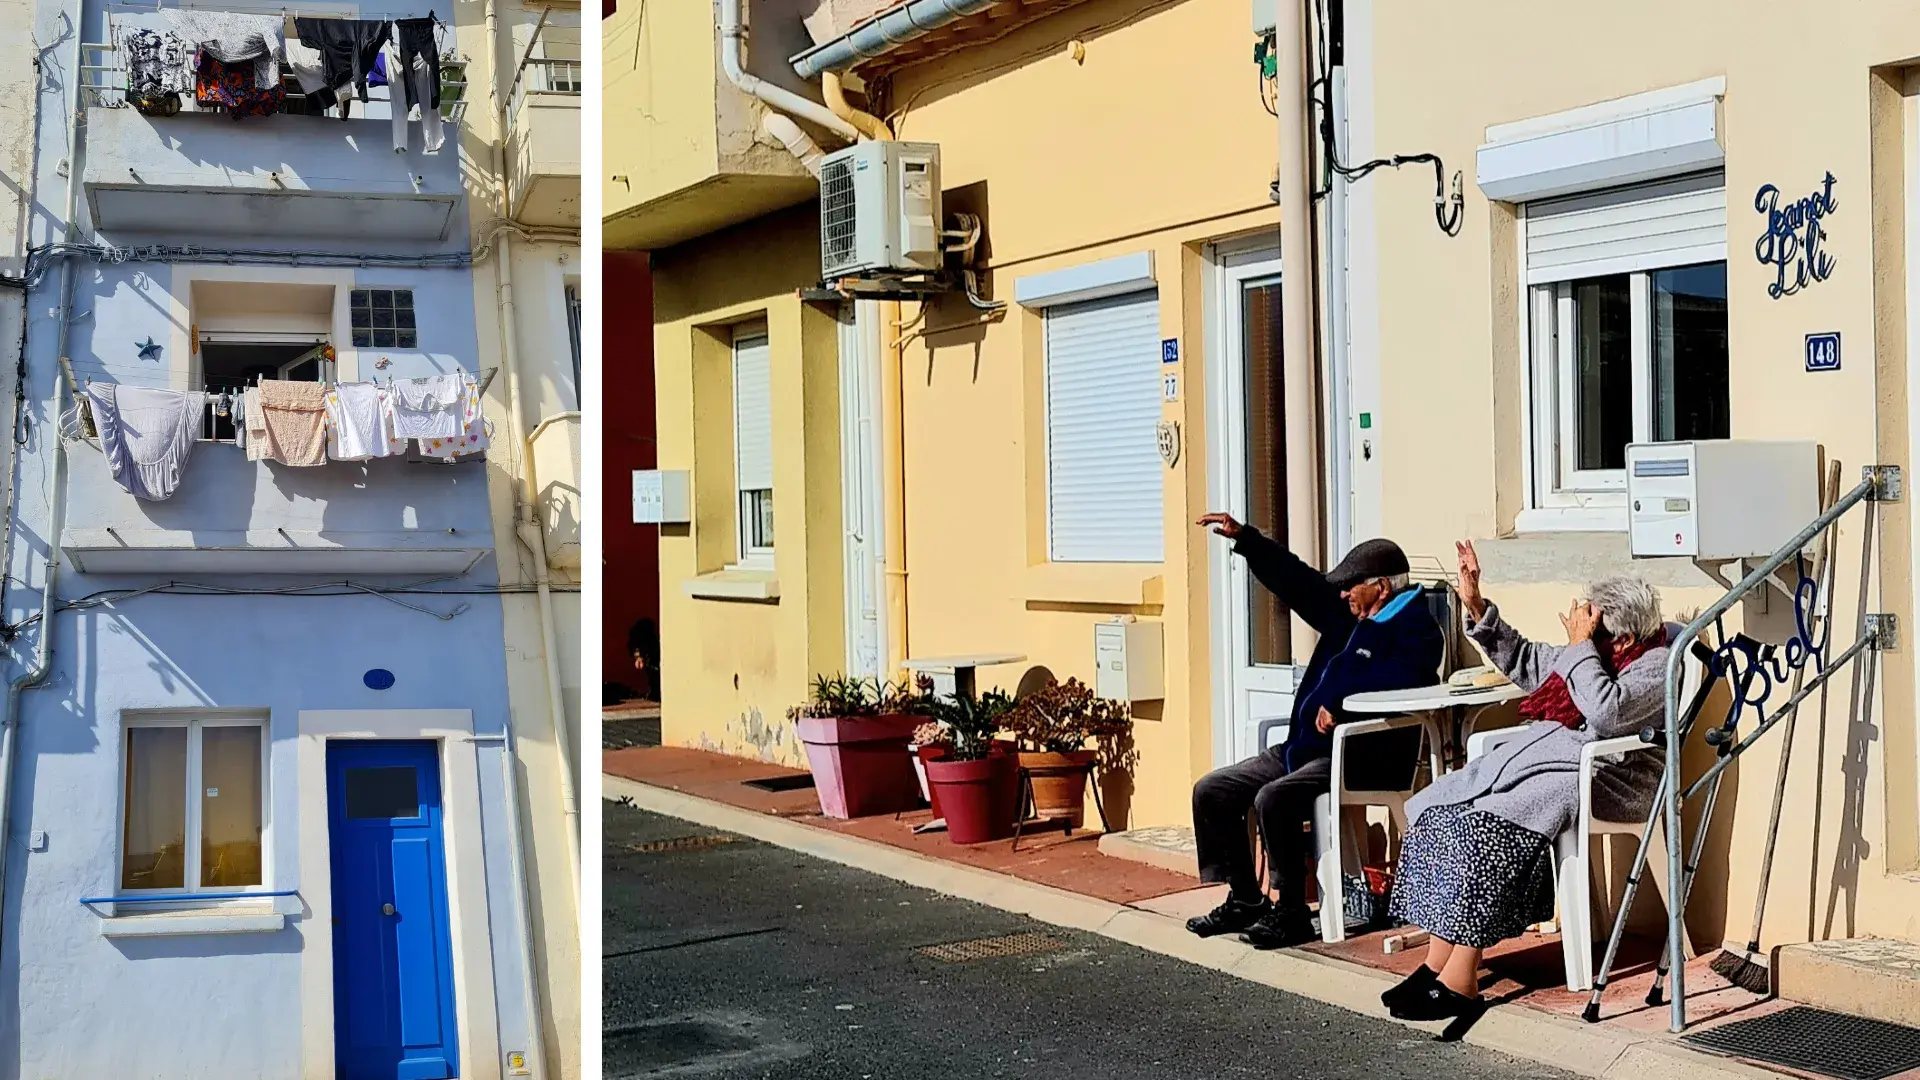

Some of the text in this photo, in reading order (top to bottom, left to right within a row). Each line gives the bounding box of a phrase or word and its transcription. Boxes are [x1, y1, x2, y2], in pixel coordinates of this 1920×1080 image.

[1768, 219, 1837, 300] Lili
[1164, 341, 1177, 360] 152
[1808, 340, 1835, 365] 148
